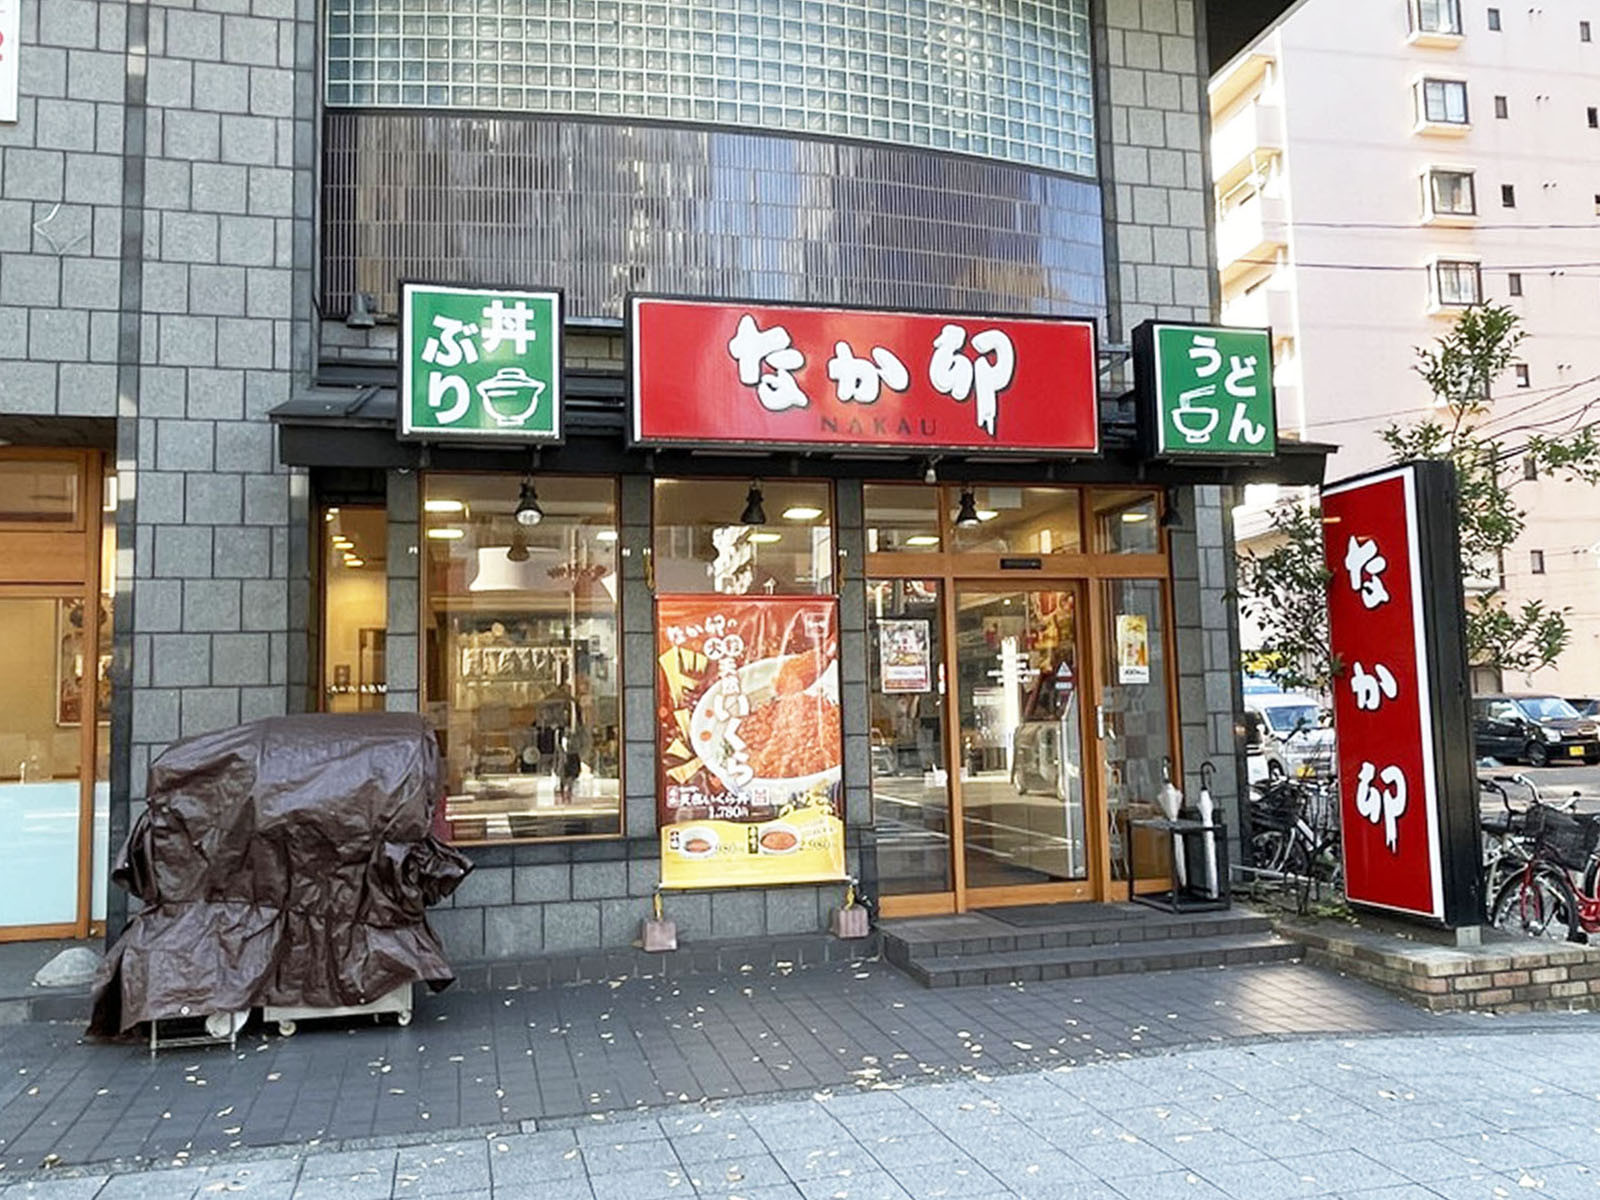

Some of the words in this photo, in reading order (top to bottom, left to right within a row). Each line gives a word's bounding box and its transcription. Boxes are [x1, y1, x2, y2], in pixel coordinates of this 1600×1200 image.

[728, 313, 1016, 437] なか卯
[820, 416, 937, 436] NAKAU
[1188, 334, 1266, 445] うどん
[1344, 535, 1407, 855] なか卯
